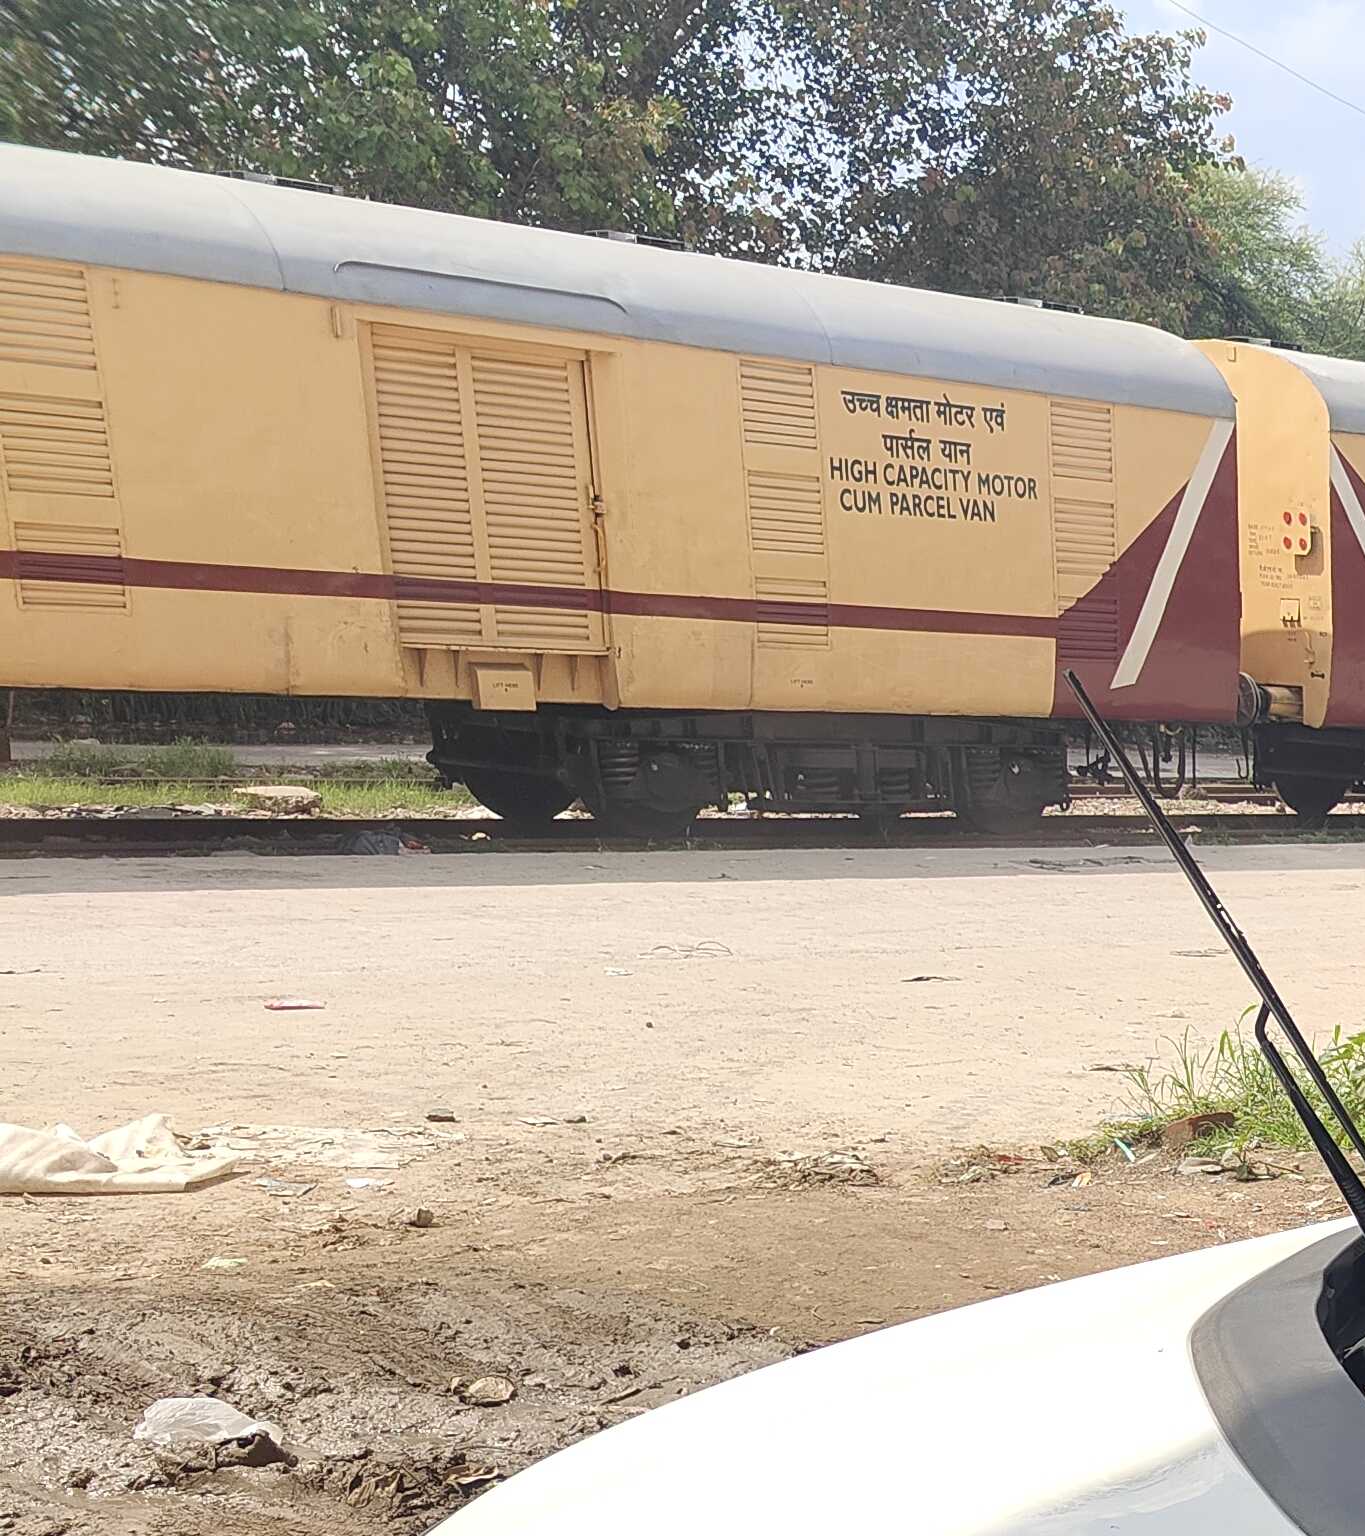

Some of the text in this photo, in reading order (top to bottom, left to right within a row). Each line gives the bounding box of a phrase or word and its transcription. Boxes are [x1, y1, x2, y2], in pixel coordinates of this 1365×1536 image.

[840, 390, 1005, 432] उच्च क्षमता मोटर एवं
[882, 429, 971, 465] पार्सल यान
[829, 457, 1038, 499] HIGH CAPACITY MOTOR
[840, 488, 995, 522] CUM PARCEL VAN
